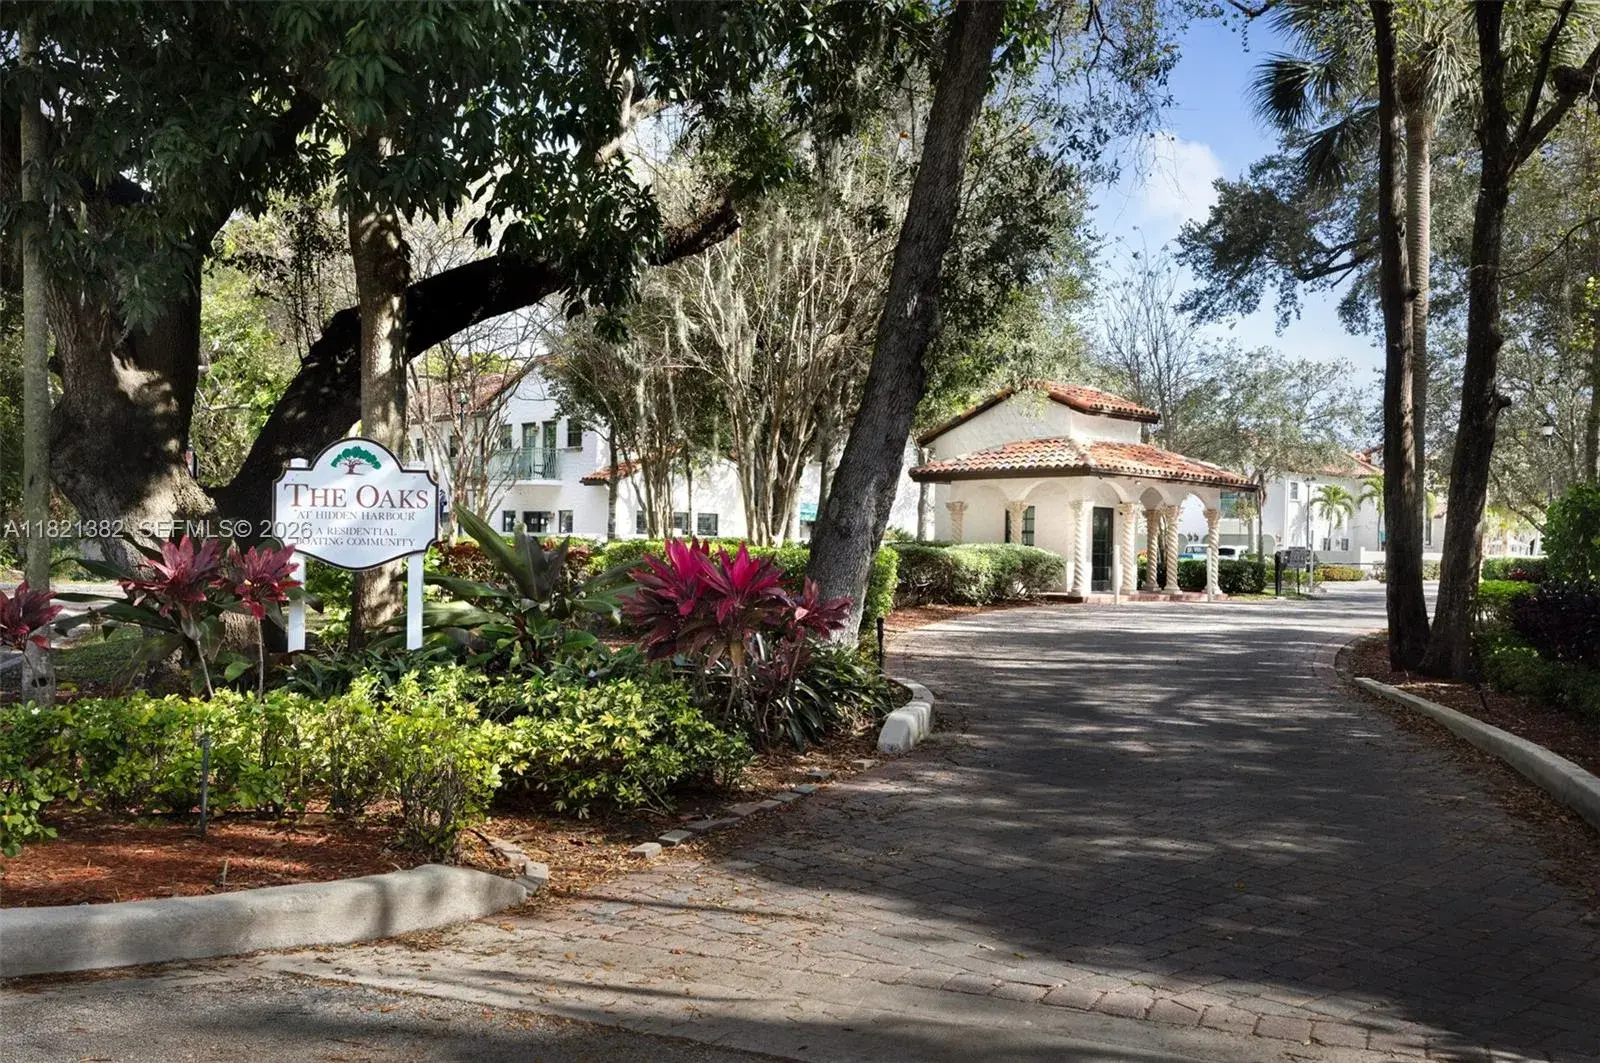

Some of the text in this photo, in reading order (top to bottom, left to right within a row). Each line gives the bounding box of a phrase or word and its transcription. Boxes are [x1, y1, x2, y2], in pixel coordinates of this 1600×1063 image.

[284, 483, 429, 509] THE OAKS
[297, 511, 416, 521] AT HIDDEN HARBOUR
[315, 527, 398, 536] A RESIDENTIAL
[346, 537, 415, 547] COMMUNITY
